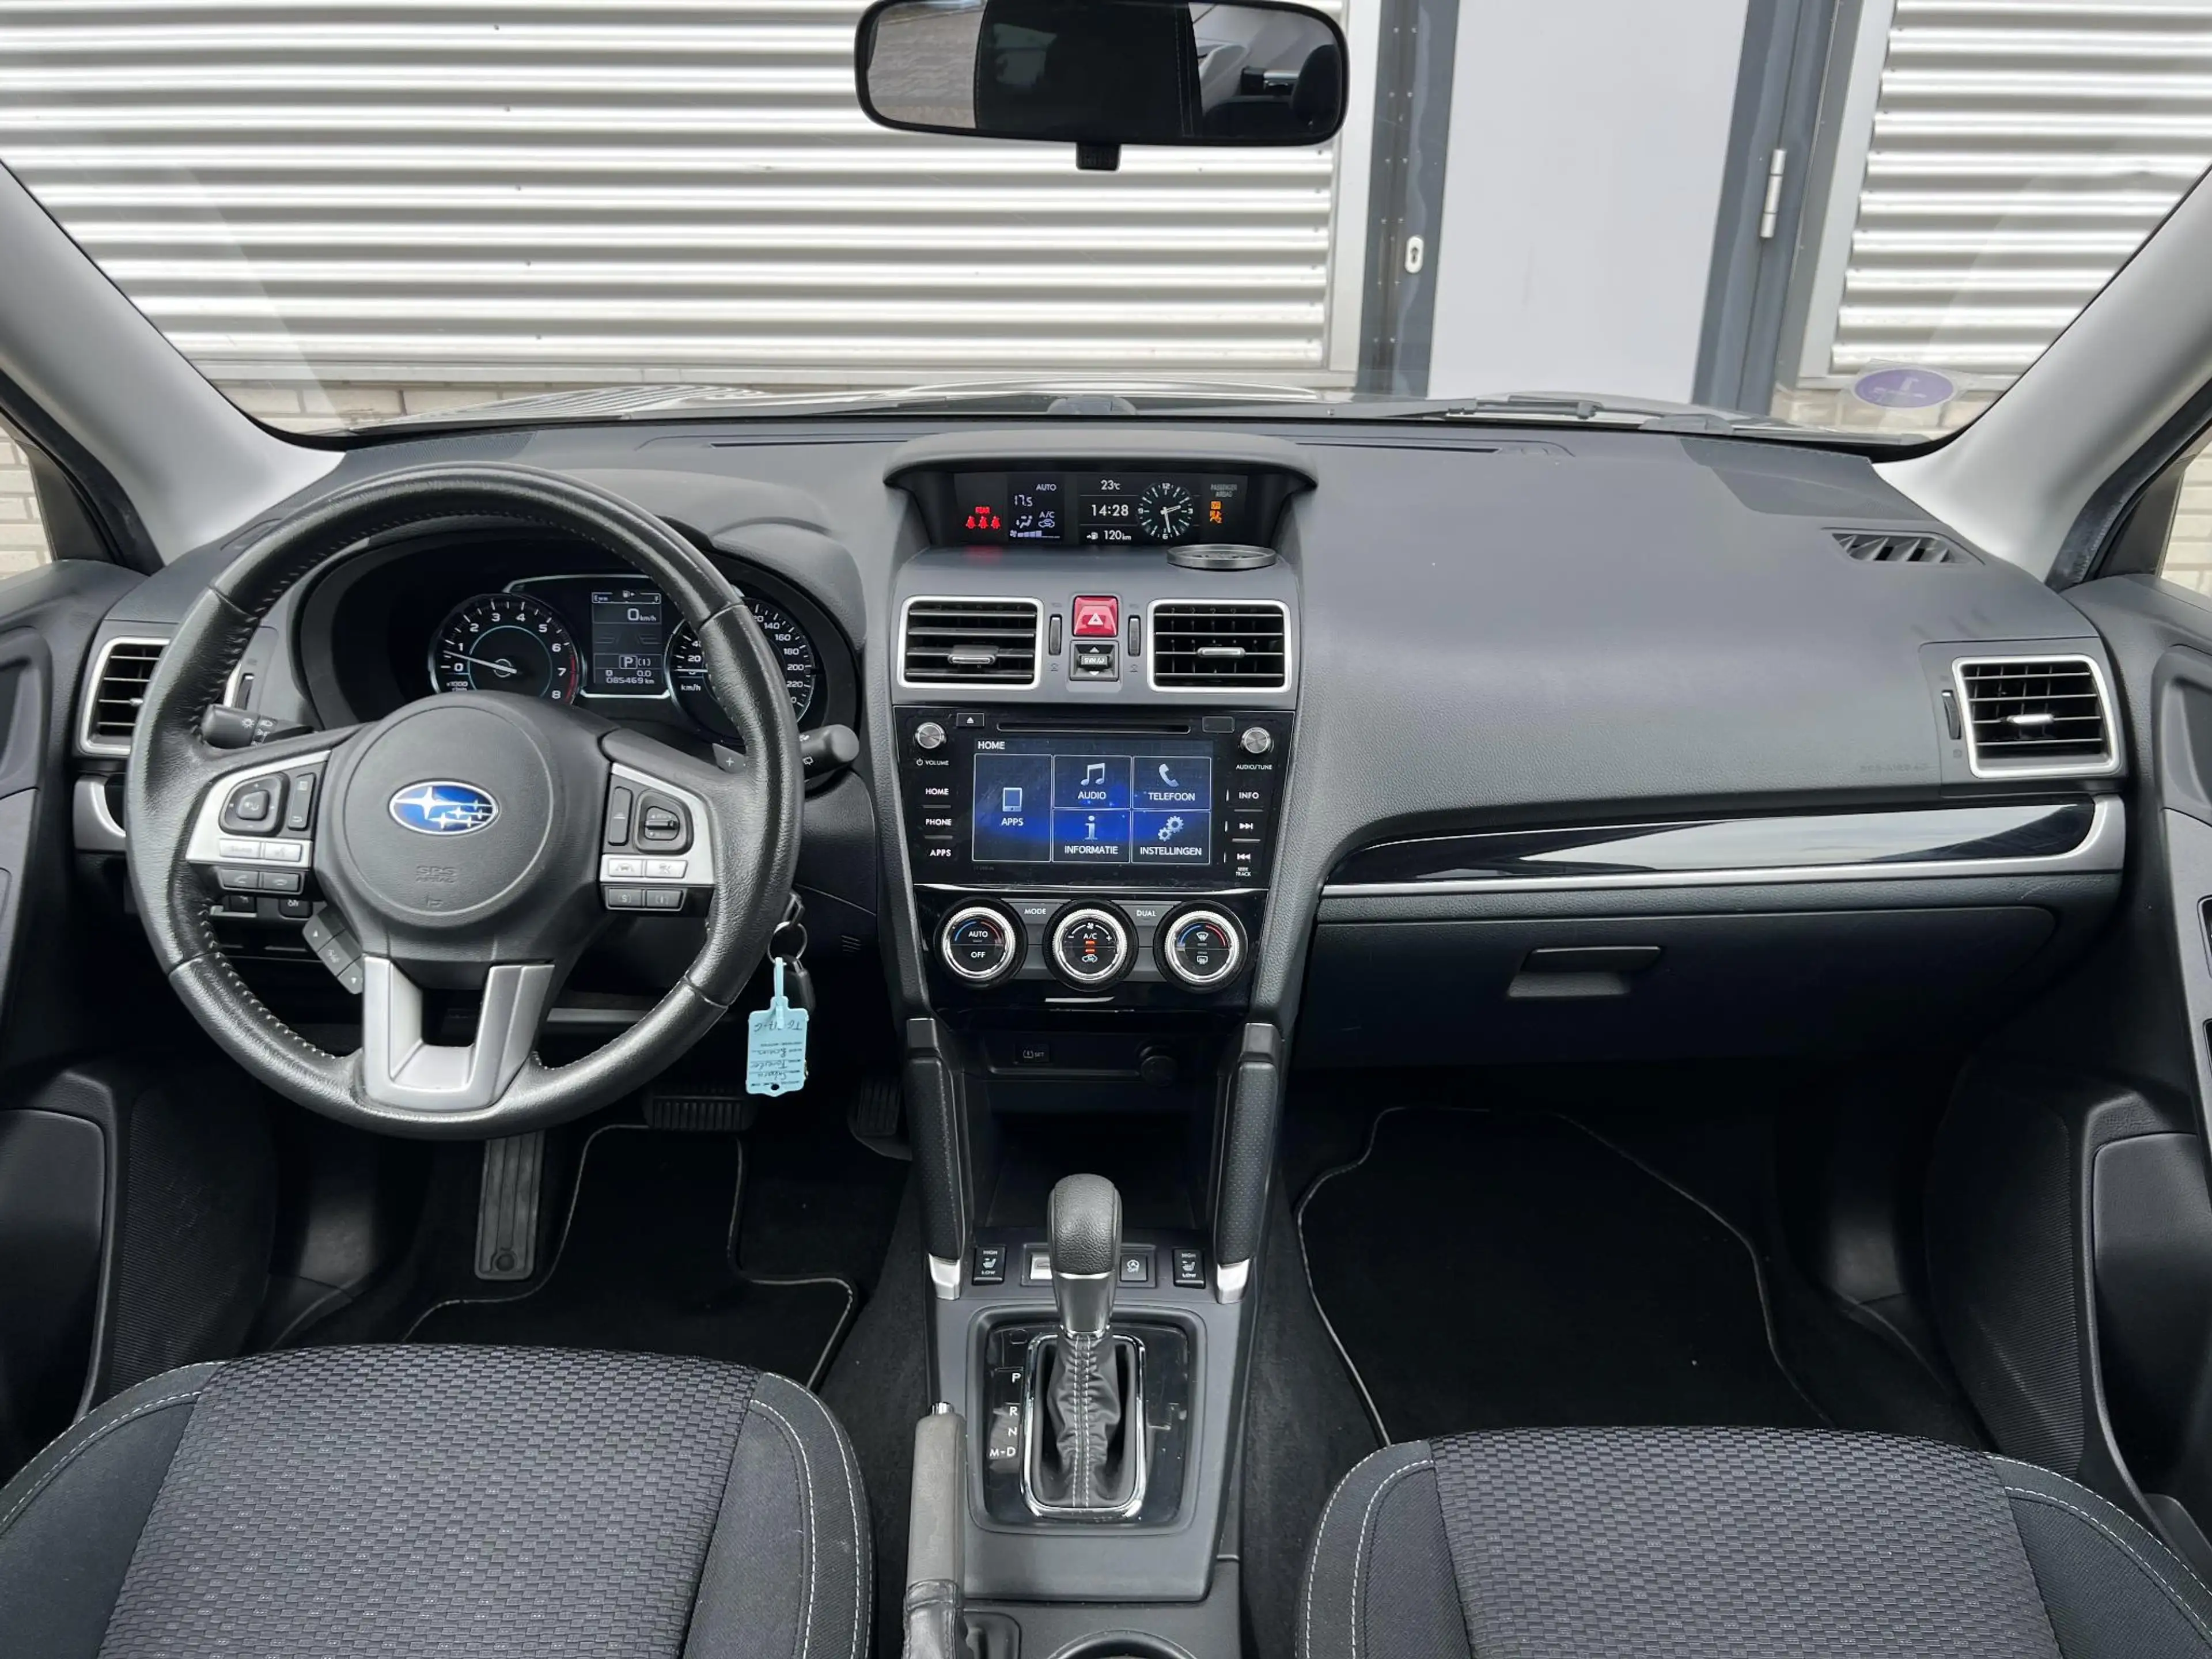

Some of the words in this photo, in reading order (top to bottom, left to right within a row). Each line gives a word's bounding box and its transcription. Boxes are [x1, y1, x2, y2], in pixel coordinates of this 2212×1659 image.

[1091, 504, 1129, 517] 14:28
[491, 613, 501, 622] 3
[516, 613, 525, 622] 4
[469, 623, 479, 632] 2
[539, 624, 548, 632] 5
[775, 634, 791, 642] 160
[458, 643, 464, 652] 1
[551, 643, 562, 652] 6
[624, 656, 633, 668] P
[687, 654, 702, 662] 20
[454, 663, 464, 672] 0
[557, 667, 567, 676] 7
[681, 683, 701, 691] km/h
[551, 690, 562, 699] 8
[978, 741, 1005, 749] HOME
[1078, 791, 1107, 800] AUDIO
[1147, 792, 1195, 801] TELEFOON
[1238, 791, 1259, 800] INFO
[1001, 817, 1024, 826] APPS
[1065, 845, 1119, 854] INFORMATIE
[1139, 846, 1202, 855] INSTELLINGEN
[1012, 1373, 1021, 1383] P
[1009, 1406, 1018, 1416] R
[1008, 1427, 1017, 1437] N
